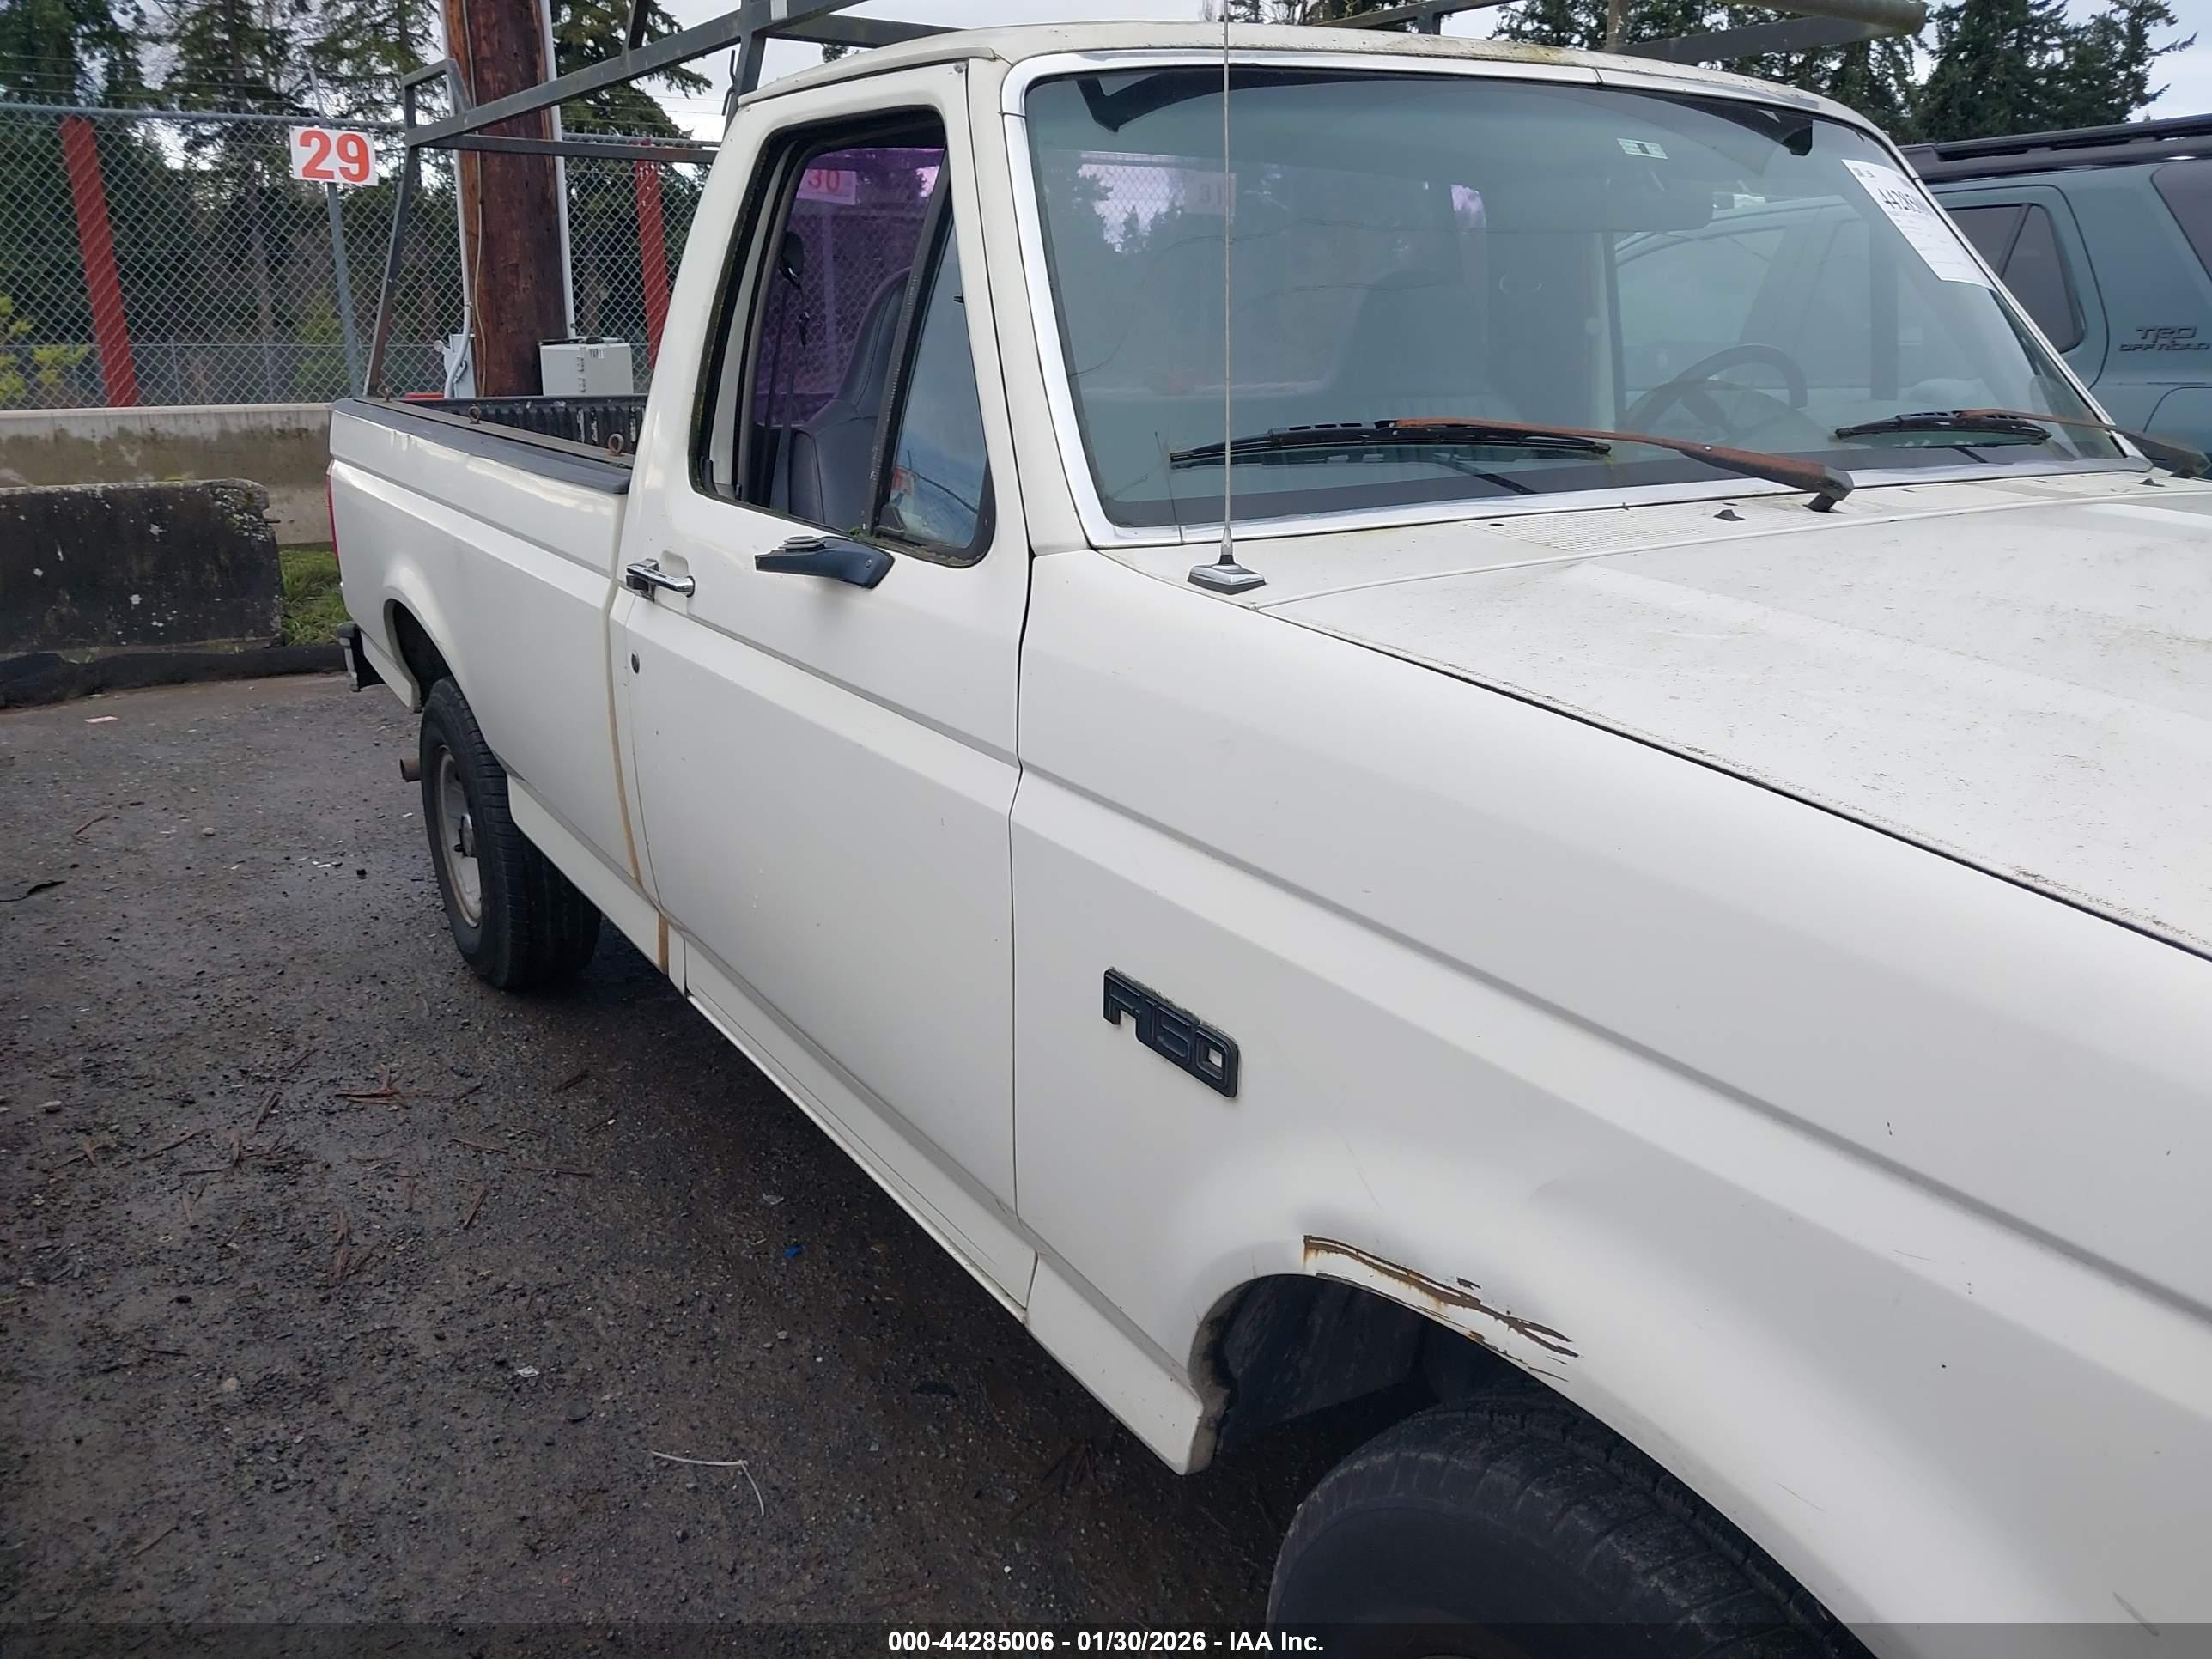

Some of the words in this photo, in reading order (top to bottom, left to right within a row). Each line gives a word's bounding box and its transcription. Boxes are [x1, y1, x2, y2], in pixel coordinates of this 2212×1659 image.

[300, 129, 369, 183] 29
[807, 169, 841, 193] 30
[2136, 327, 2197, 343] TRD
[2157, 343, 2210, 351] ROAD
